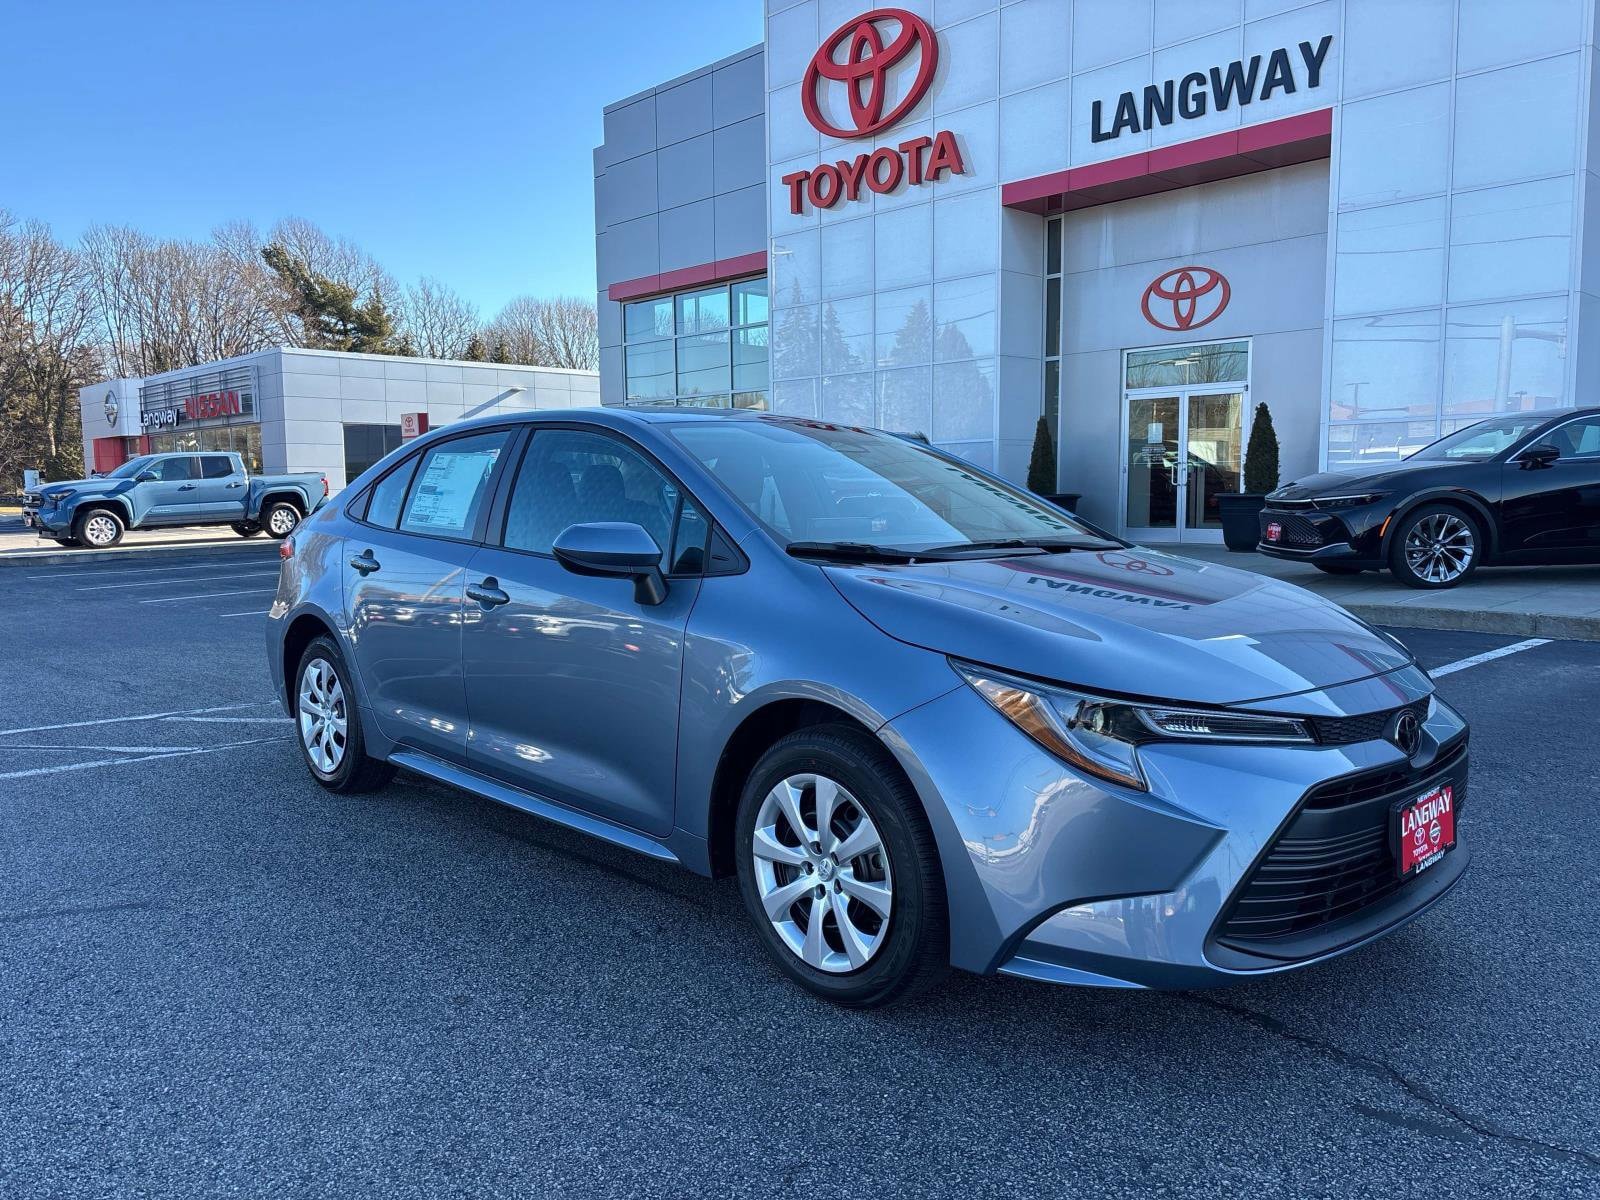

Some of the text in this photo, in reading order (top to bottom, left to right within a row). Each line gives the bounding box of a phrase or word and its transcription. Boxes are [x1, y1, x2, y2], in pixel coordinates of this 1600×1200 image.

[1091, 35, 1333, 143] LANGWAY
[782, 130, 964, 214] TOYOTA
[140, 408, 178, 428] Langway
[184, 390, 241, 419] NISSAN
[1402, 792, 1451, 837] LANGWAY
[1412, 844, 1428, 857] TOYOTA
[1416, 849, 1445, 874] LANGWAY
